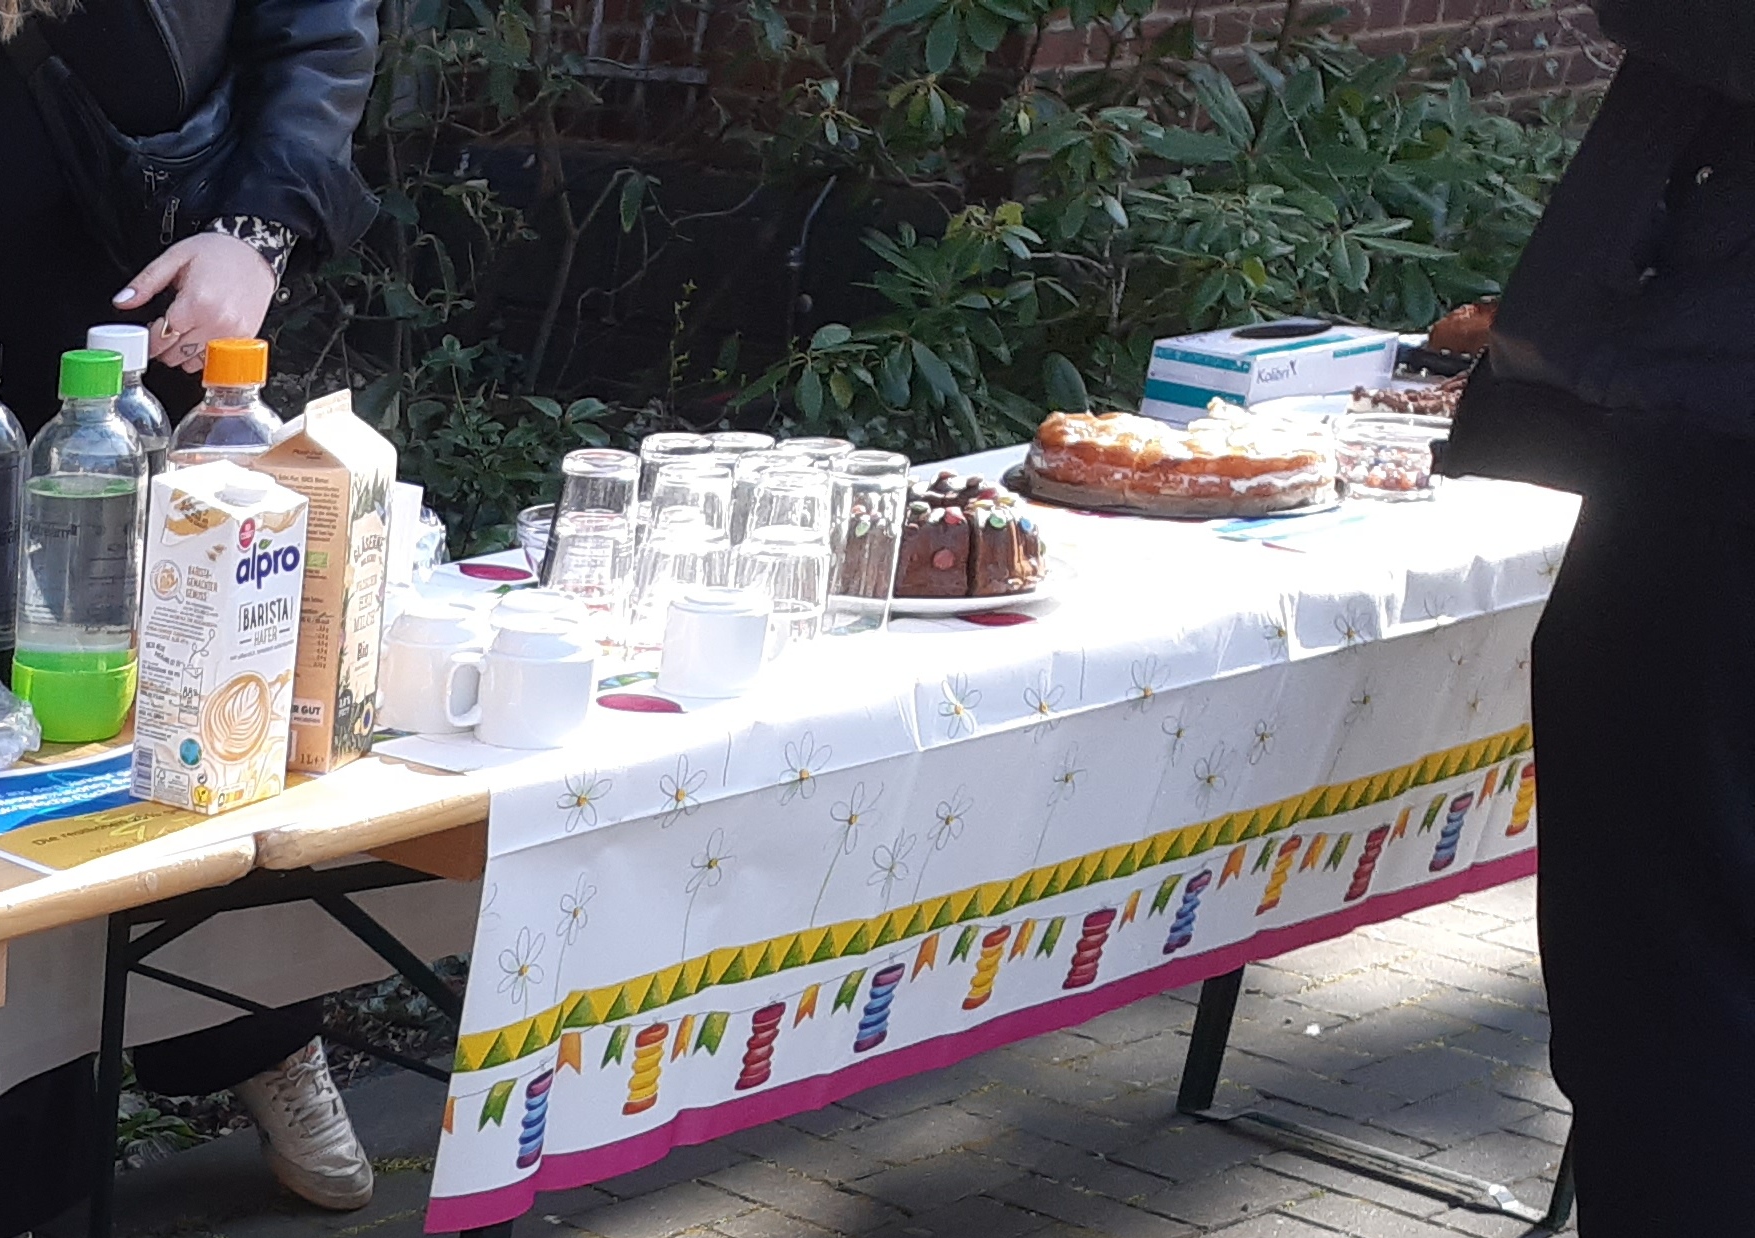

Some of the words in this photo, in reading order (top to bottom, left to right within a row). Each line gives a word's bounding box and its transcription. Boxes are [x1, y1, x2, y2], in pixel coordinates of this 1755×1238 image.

[236, 542, 300, 589] alpro
[243, 598, 288, 631] BARISTA
[254, 625, 277, 646] HAFER
[301, 706, 321, 715] GUT
